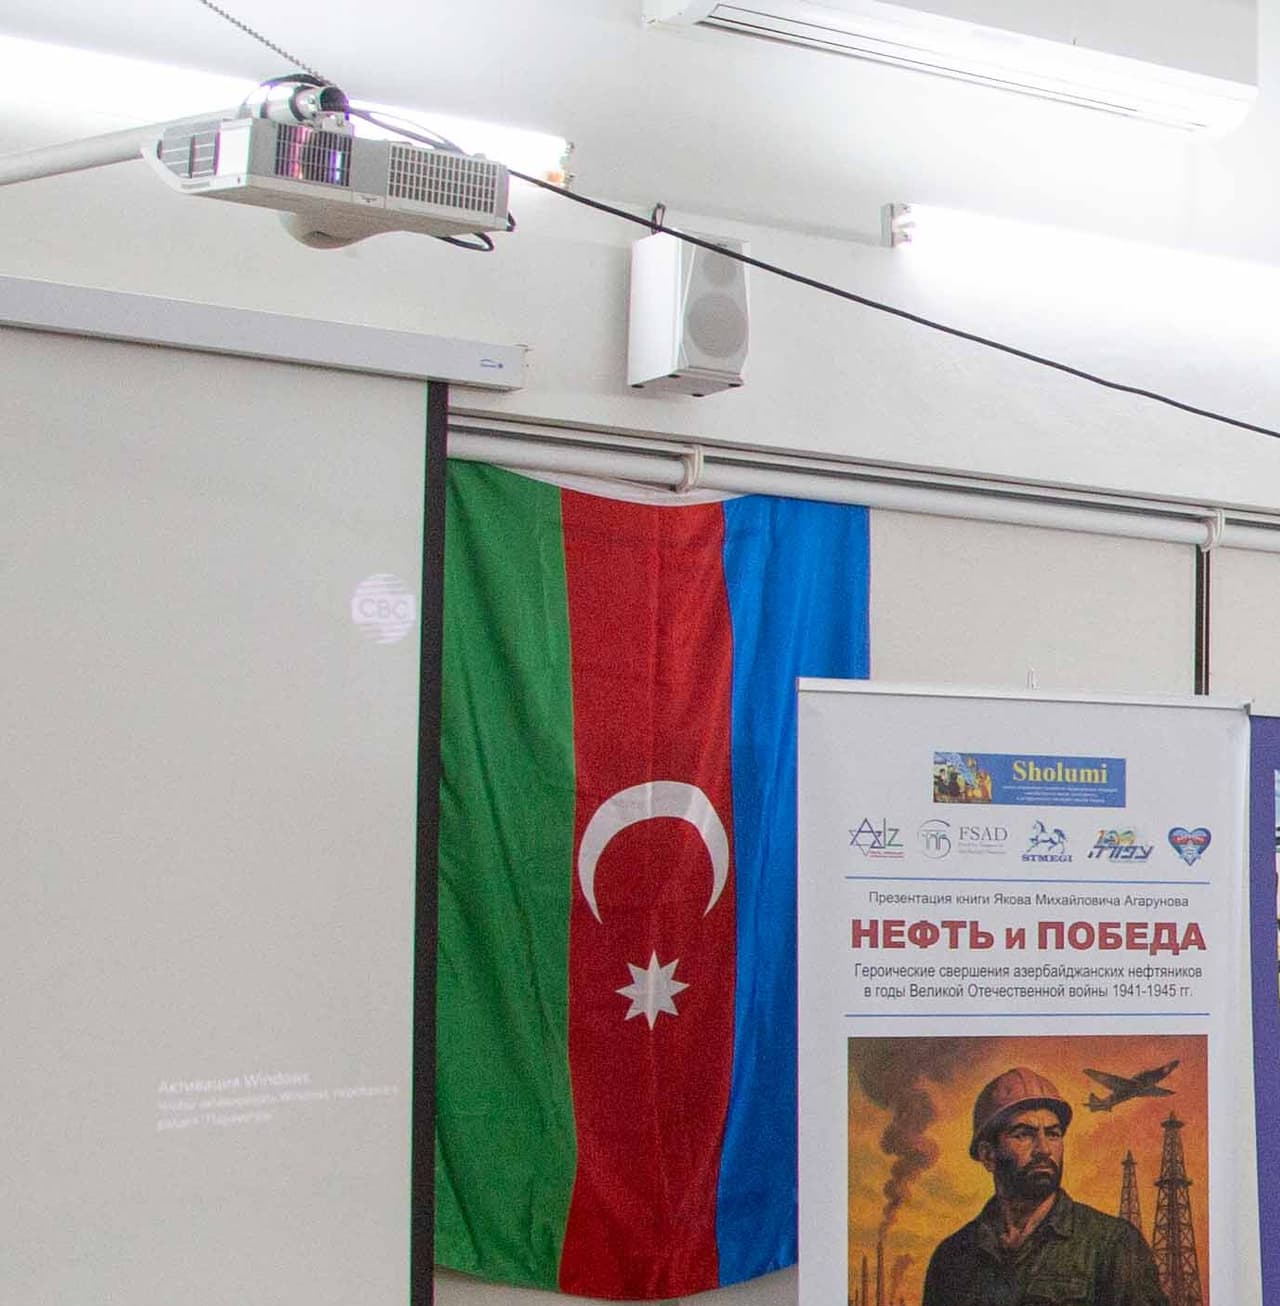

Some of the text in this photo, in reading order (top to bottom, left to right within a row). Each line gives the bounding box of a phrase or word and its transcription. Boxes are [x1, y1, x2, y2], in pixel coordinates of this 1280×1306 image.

[1012, 759, 1108, 784] Sholumi
[959, 826, 1008, 842] FSAD
[1021, 854, 1072, 863] STMEGI
[868, 891, 1189, 909] Презентация книги Якова Михайловича Агарунова
[851, 919, 1207, 956] НЕФТЬ и ПОБЕДА
[854, 963, 1203, 982] Героические свершения азербайджанских нефтяников
[864, 987, 872, 997] в
[875, 986, 906, 998] годы
[909, 984, 964, 998] Великой
[967, 984, 1065, 999] Отечественной
[1068, 985, 1109, 998] войны
[1113, 984, 1177, 997] 1941-1945
